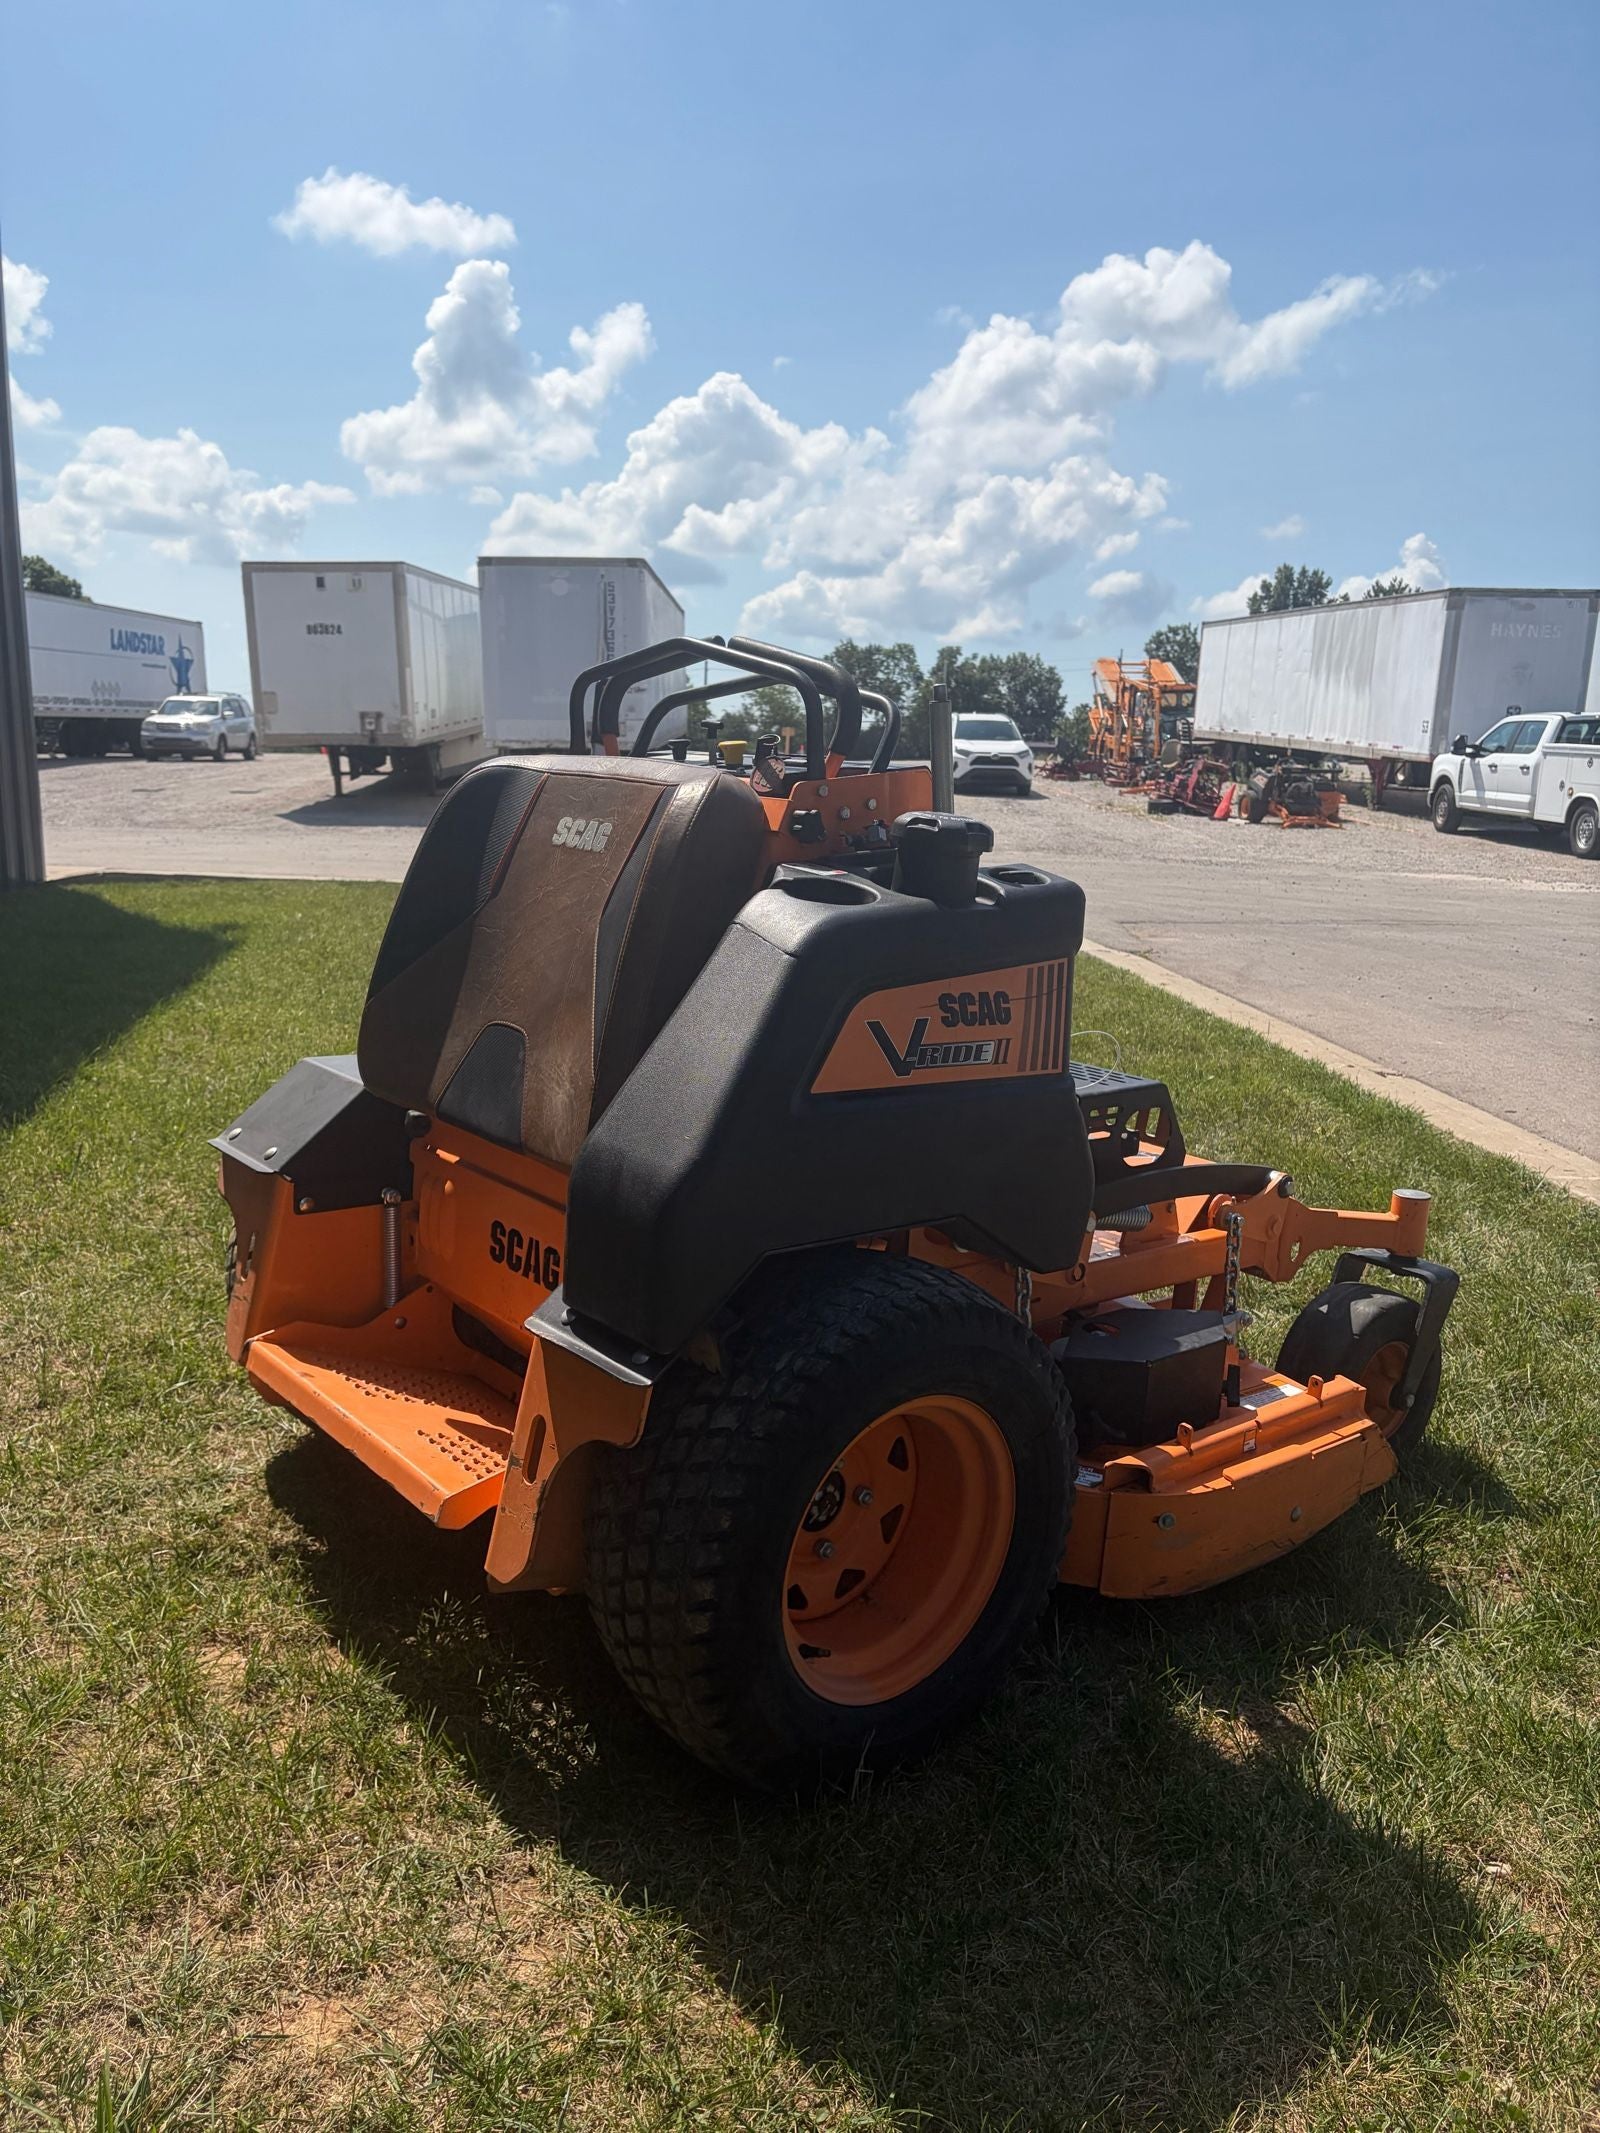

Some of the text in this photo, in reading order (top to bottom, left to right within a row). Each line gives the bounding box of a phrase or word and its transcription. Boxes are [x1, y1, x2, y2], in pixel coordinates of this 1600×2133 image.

[110, 628, 166, 656] LANDSTAR
[1490, 622, 1562, 639] HAYNES
[551, 816, 613, 854] SCAG
[938, 990, 1012, 1028] SCAG
[489, 1219, 561, 1291] SCAG
